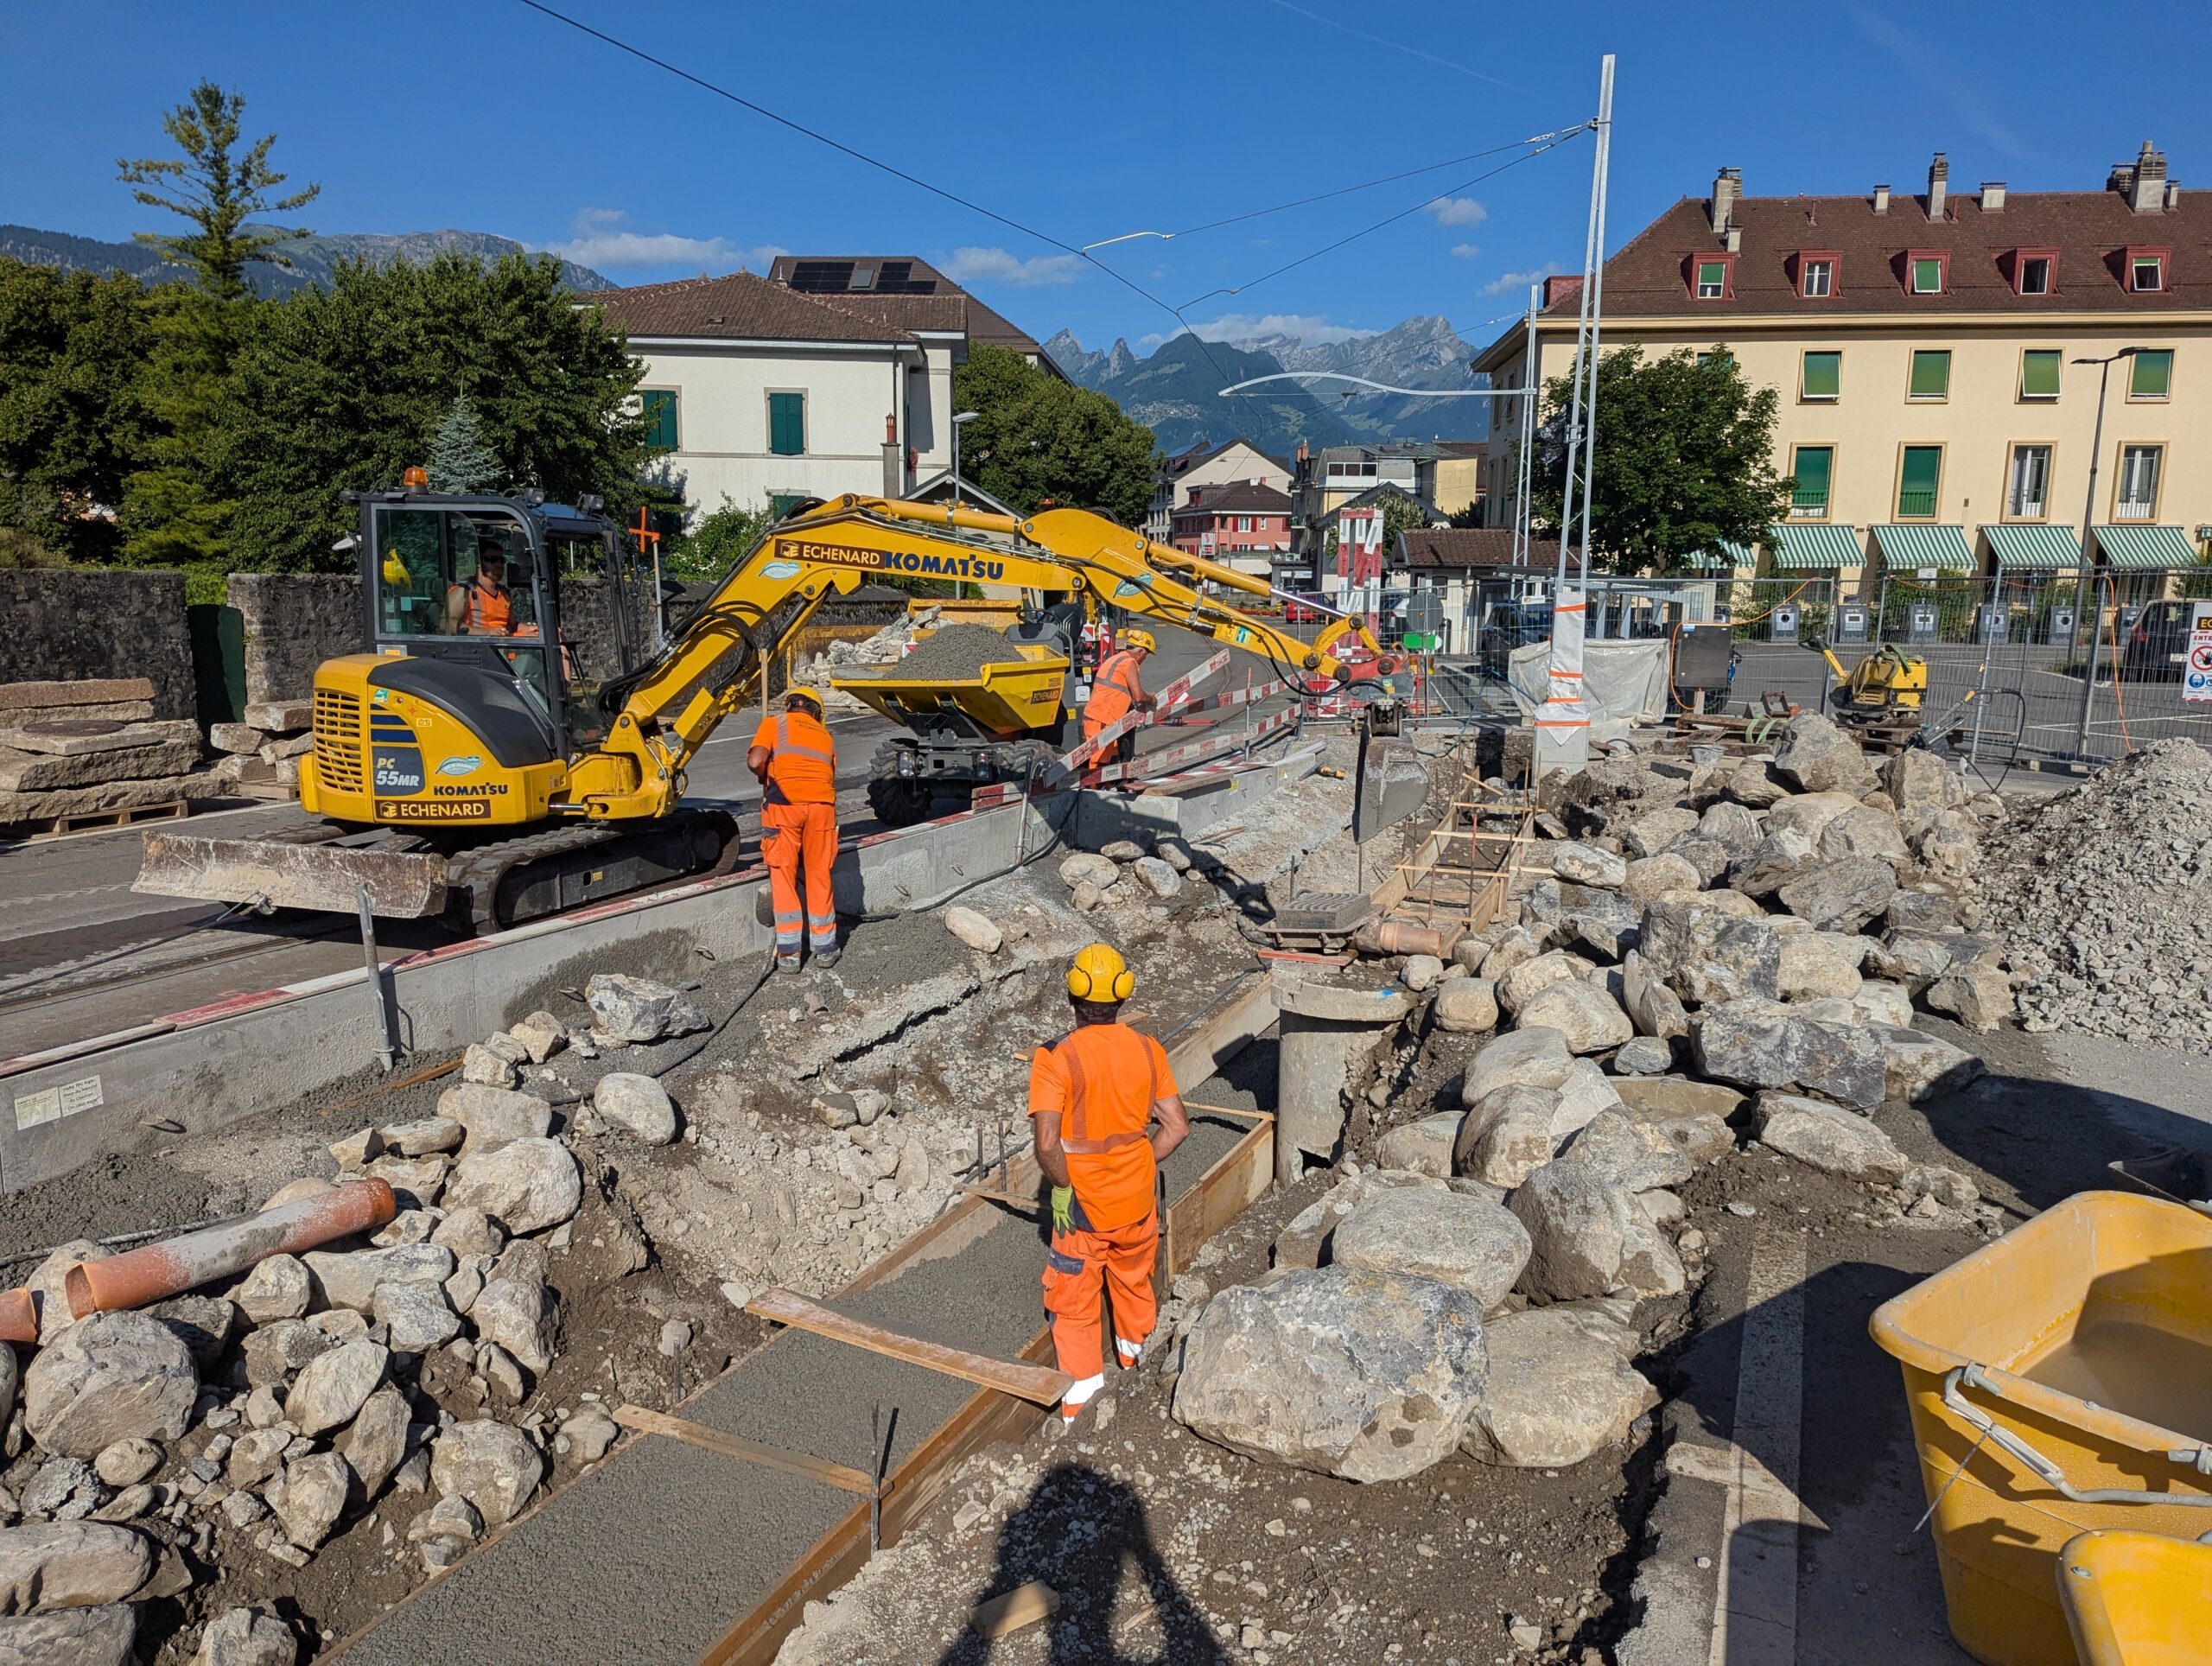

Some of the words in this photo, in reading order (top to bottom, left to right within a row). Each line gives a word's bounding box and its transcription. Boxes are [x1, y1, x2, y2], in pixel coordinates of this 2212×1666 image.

[803, 544, 880, 566] ECHENARD
[885, 551, 1004, 581] KOMATSU
[377, 757, 396, 770] PC
[375, 770, 421, 787] 55MR
[433, 782, 508, 796] KOMATSU
[400, 803, 485, 817] ECHENARD
